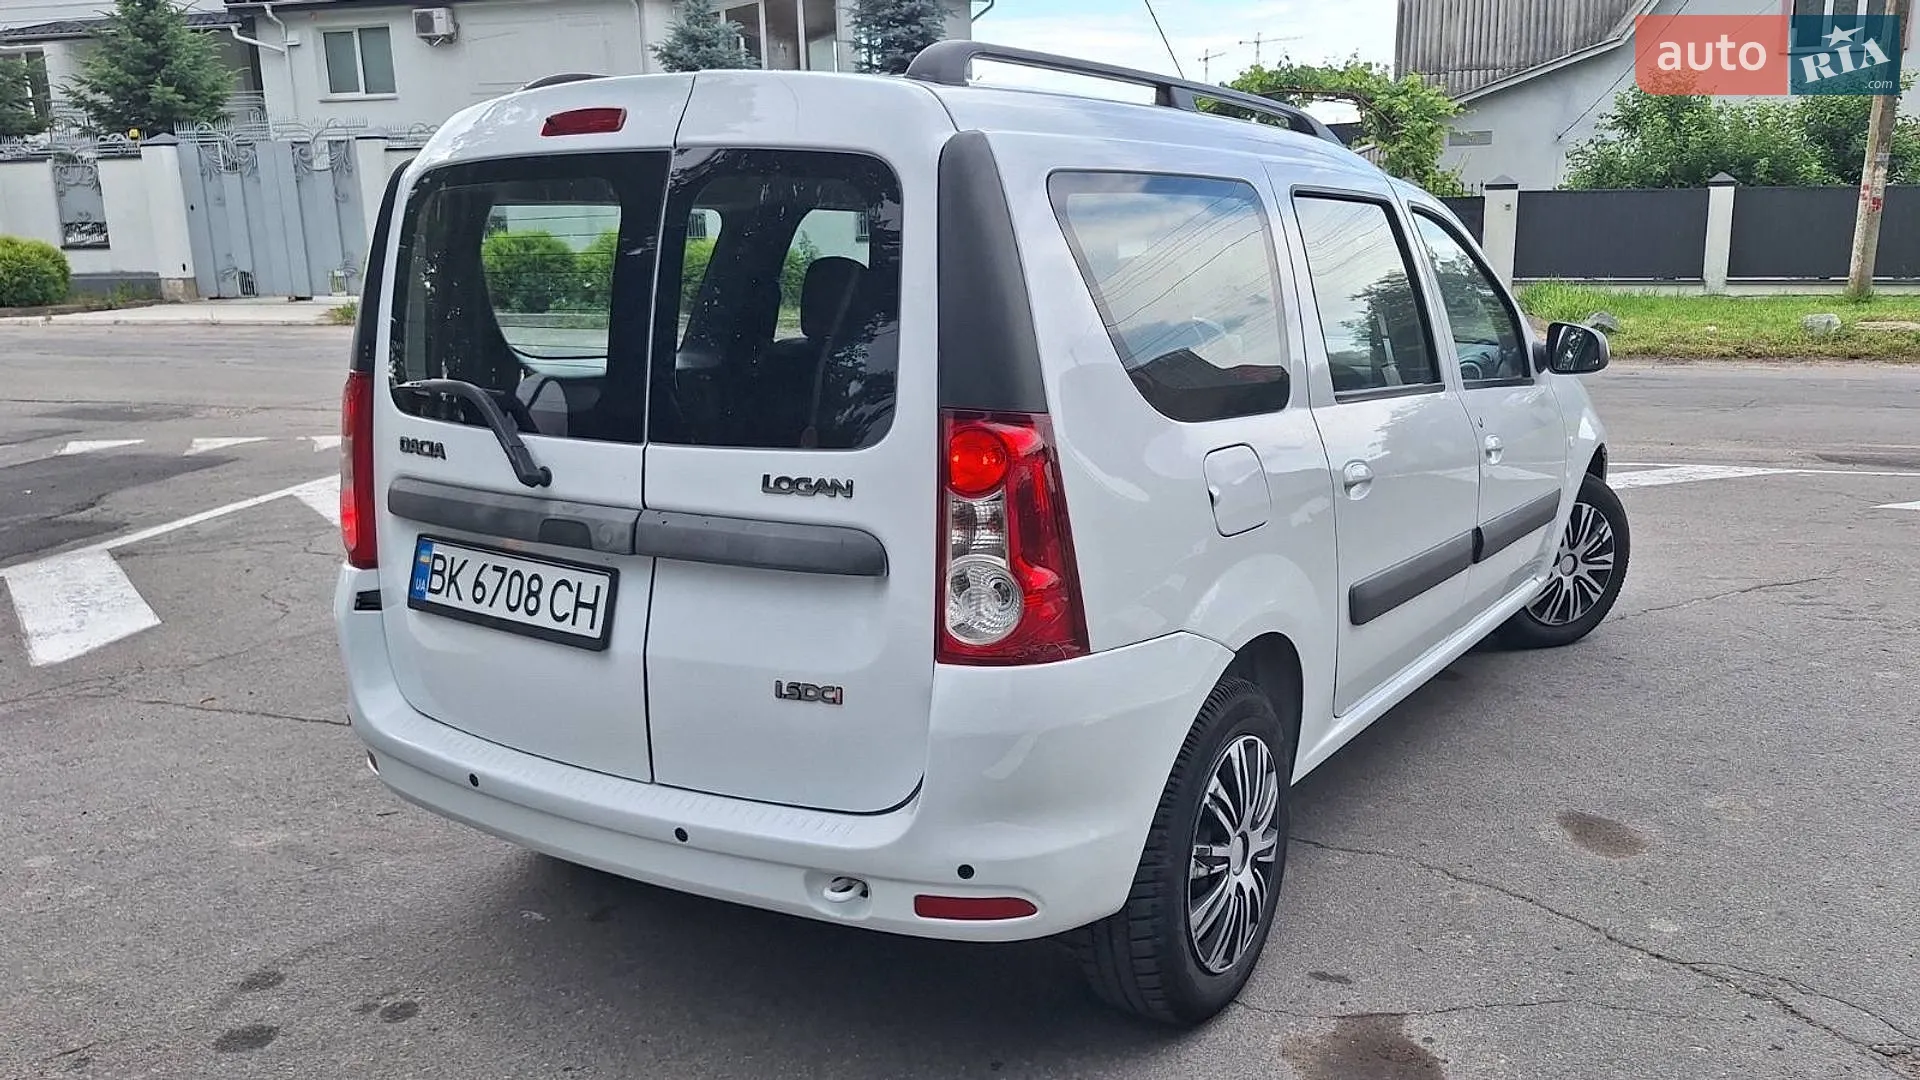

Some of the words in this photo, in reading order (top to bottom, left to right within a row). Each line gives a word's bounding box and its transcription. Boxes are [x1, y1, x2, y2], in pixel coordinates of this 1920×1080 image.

[399, 436, 447, 460] DACIA
[761, 474, 854, 499] LOGAN
[415, 577, 426, 592] UA
[428, 553, 468, 601] BK
[471, 563, 543, 617] 6708
[549, 578, 601, 630] CH
